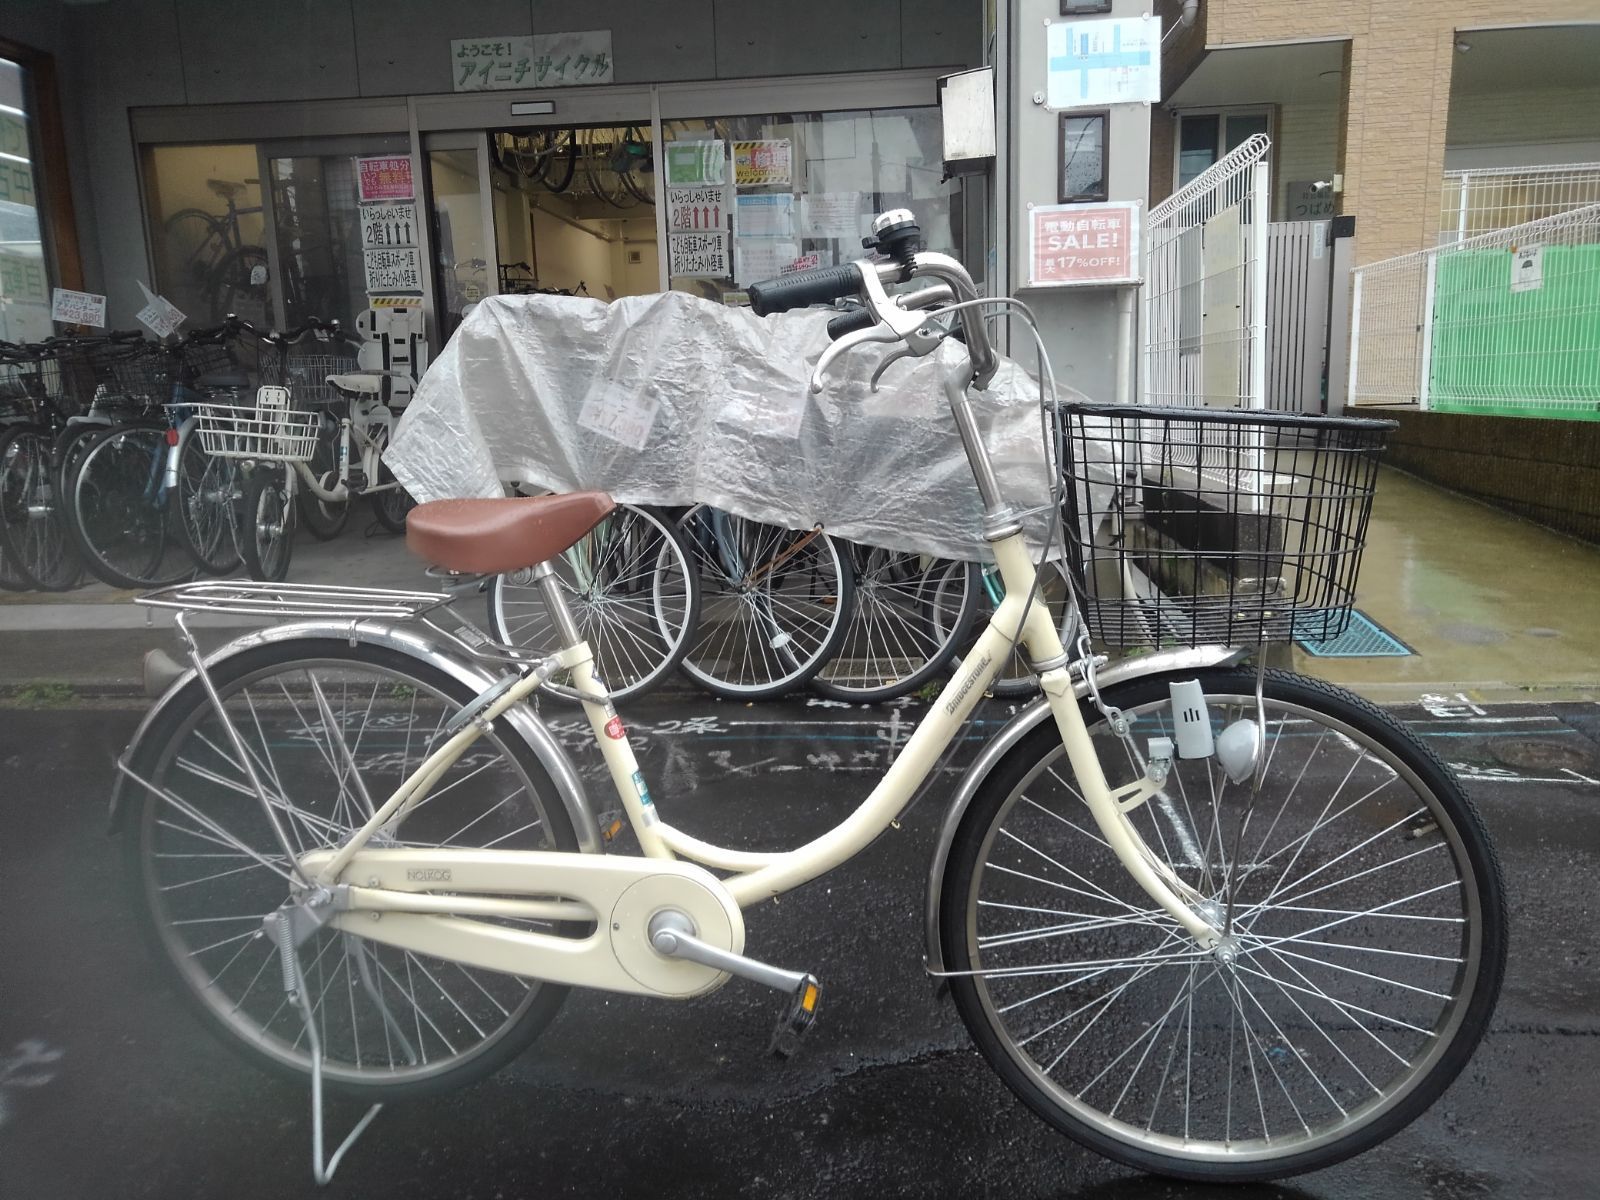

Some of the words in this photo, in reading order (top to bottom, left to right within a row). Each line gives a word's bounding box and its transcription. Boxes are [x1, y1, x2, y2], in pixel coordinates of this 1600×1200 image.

[457, 43, 512, 57] ようこそ!
[458, 53, 609, 86] アイニチサイクル
[670, 190, 722, 204] いらっしゃいませ
[362, 206, 412, 221] いらっしゃいませ
[673, 206, 692, 229] 2階
[366, 222, 384, 245] 2階
[1045, 218, 1122, 233] 電動自転車
[1047, 232, 1119, 251] SALE!
